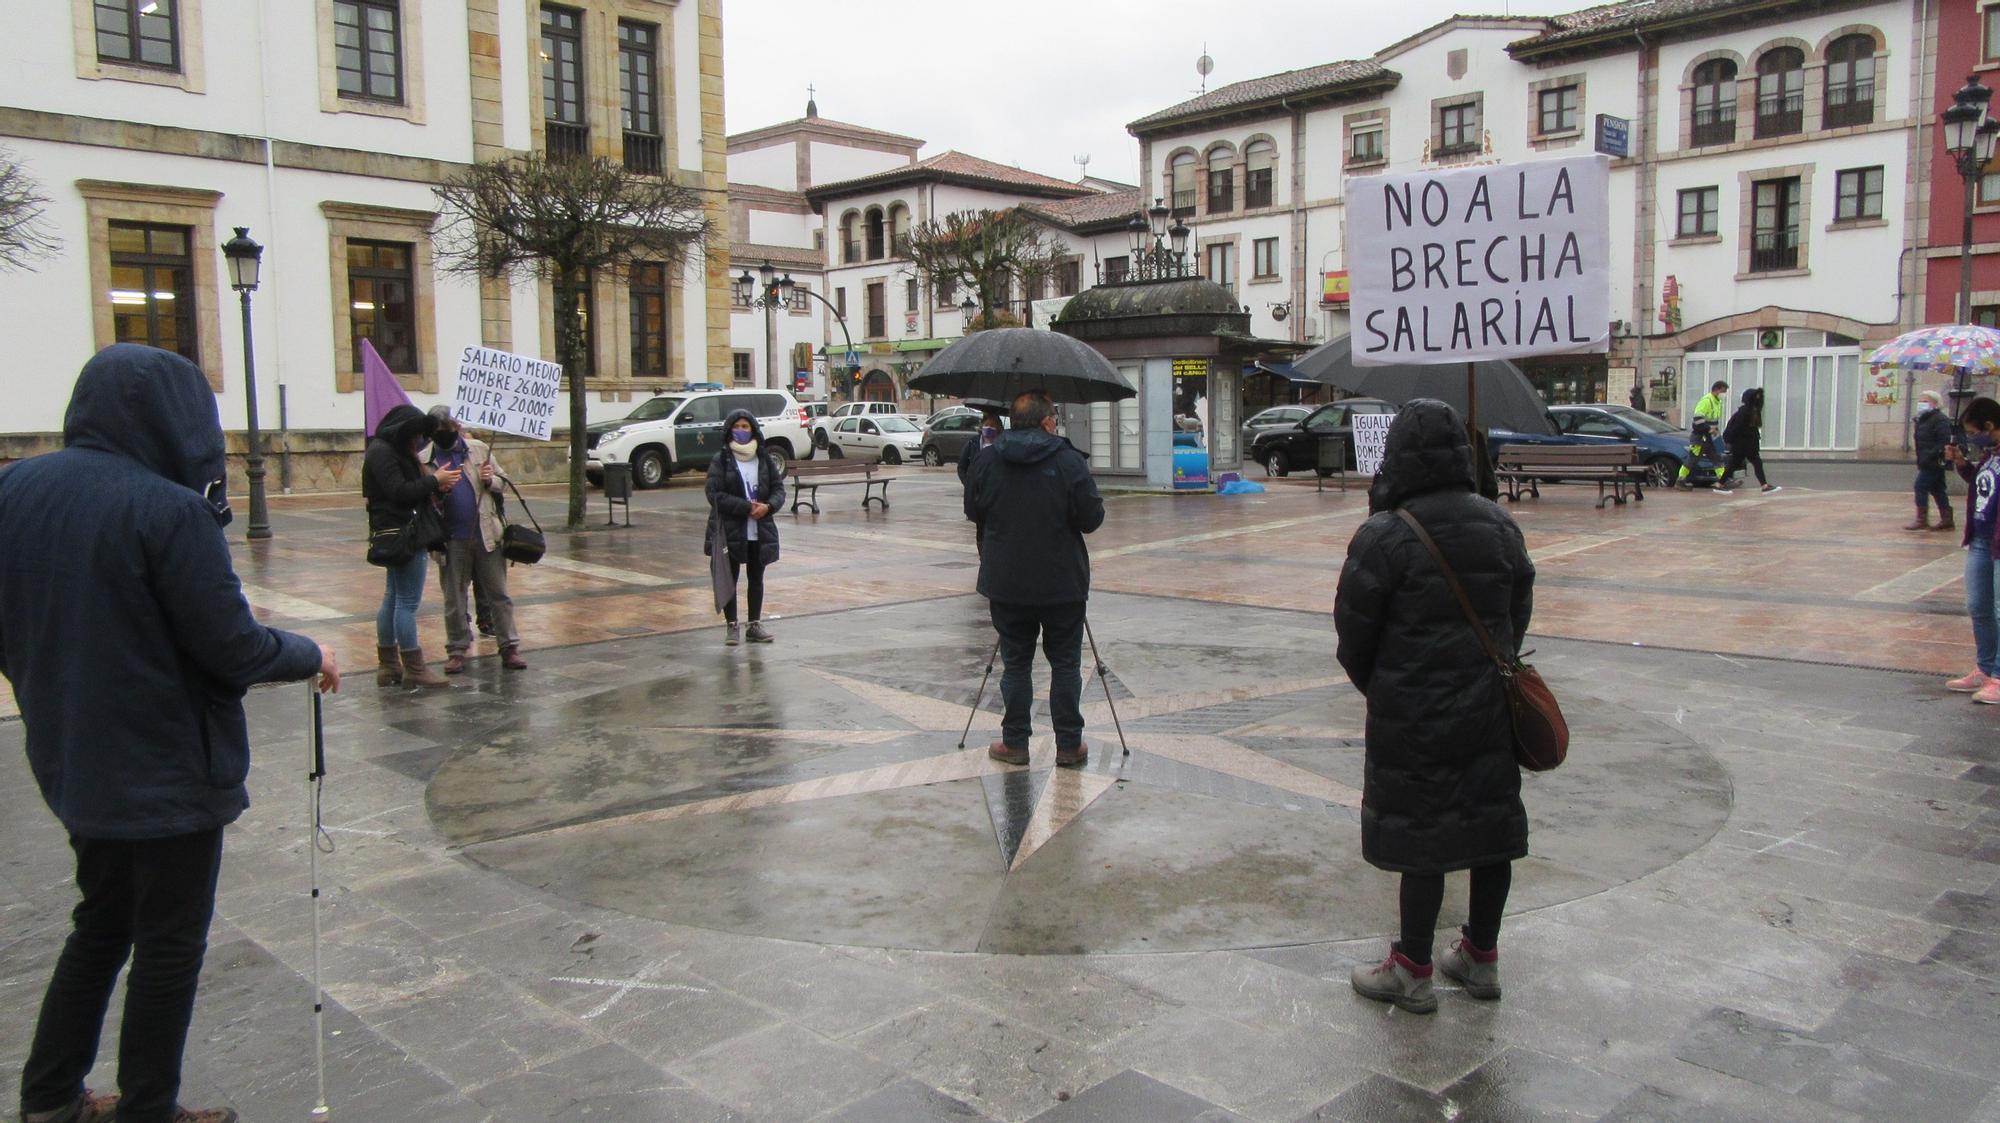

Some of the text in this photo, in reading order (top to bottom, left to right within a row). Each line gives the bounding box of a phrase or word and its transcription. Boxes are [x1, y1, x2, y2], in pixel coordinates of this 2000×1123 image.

[1384, 167, 1574, 231] NO A LA
[1391, 231, 1583, 292] BRECHA
[459, 366, 512, 391] HOMBRE
[462, 347, 561, 382] SALARIO MEDIO
[455, 405, 474, 421] AL
[478, 408, 506, 428] AÑO
[456, 385, 555, 418] MUJER 20.000€
[1359, 460, 1370, 473] DE
